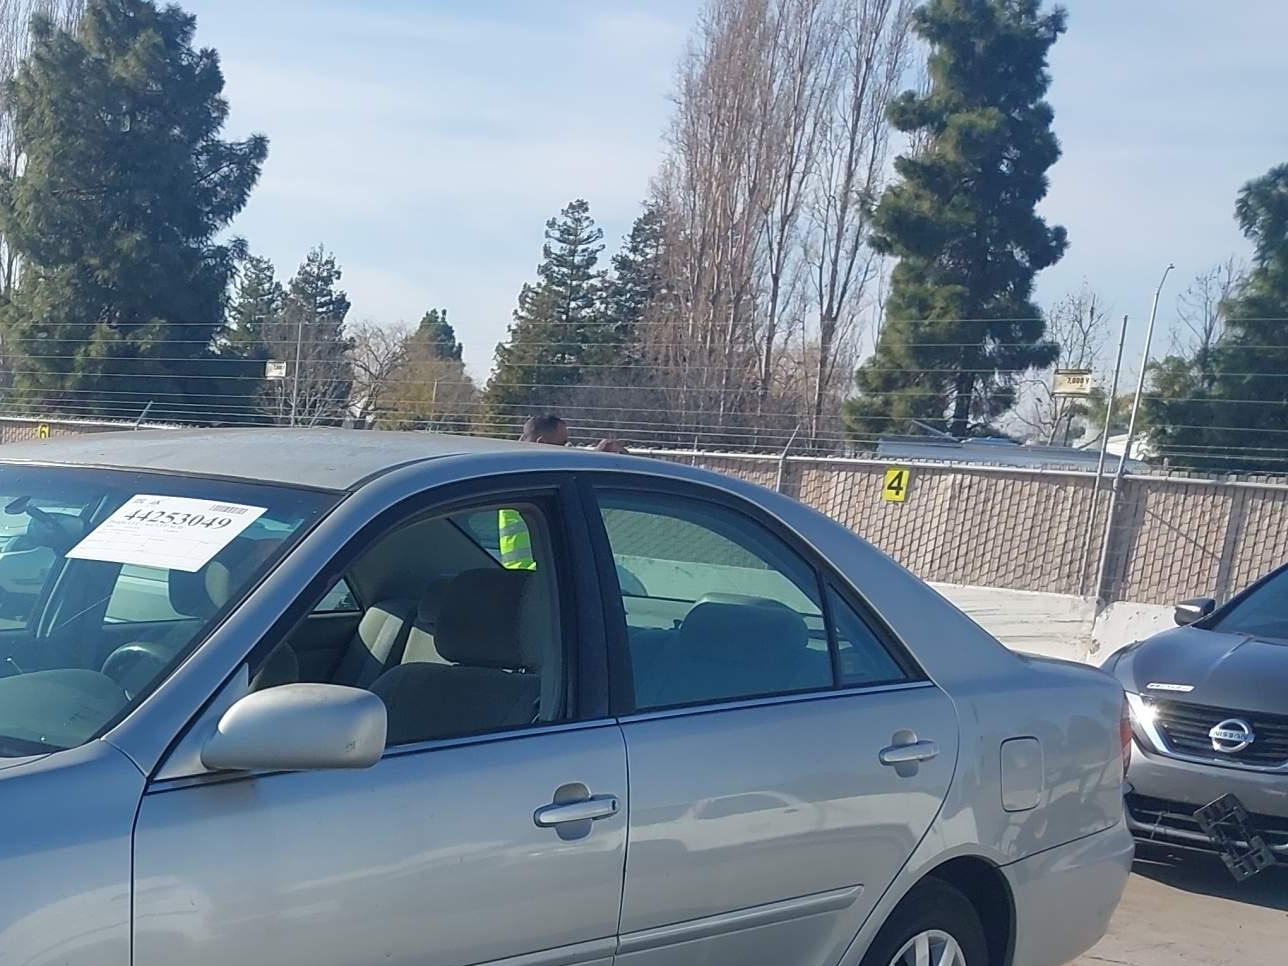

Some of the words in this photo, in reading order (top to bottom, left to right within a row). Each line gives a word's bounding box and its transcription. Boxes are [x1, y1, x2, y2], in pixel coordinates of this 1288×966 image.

[886, 470, 904, 496] 4
[124, 508, 232, 530] 44253049
[1214, 731, 1249, 740] NISSAN
